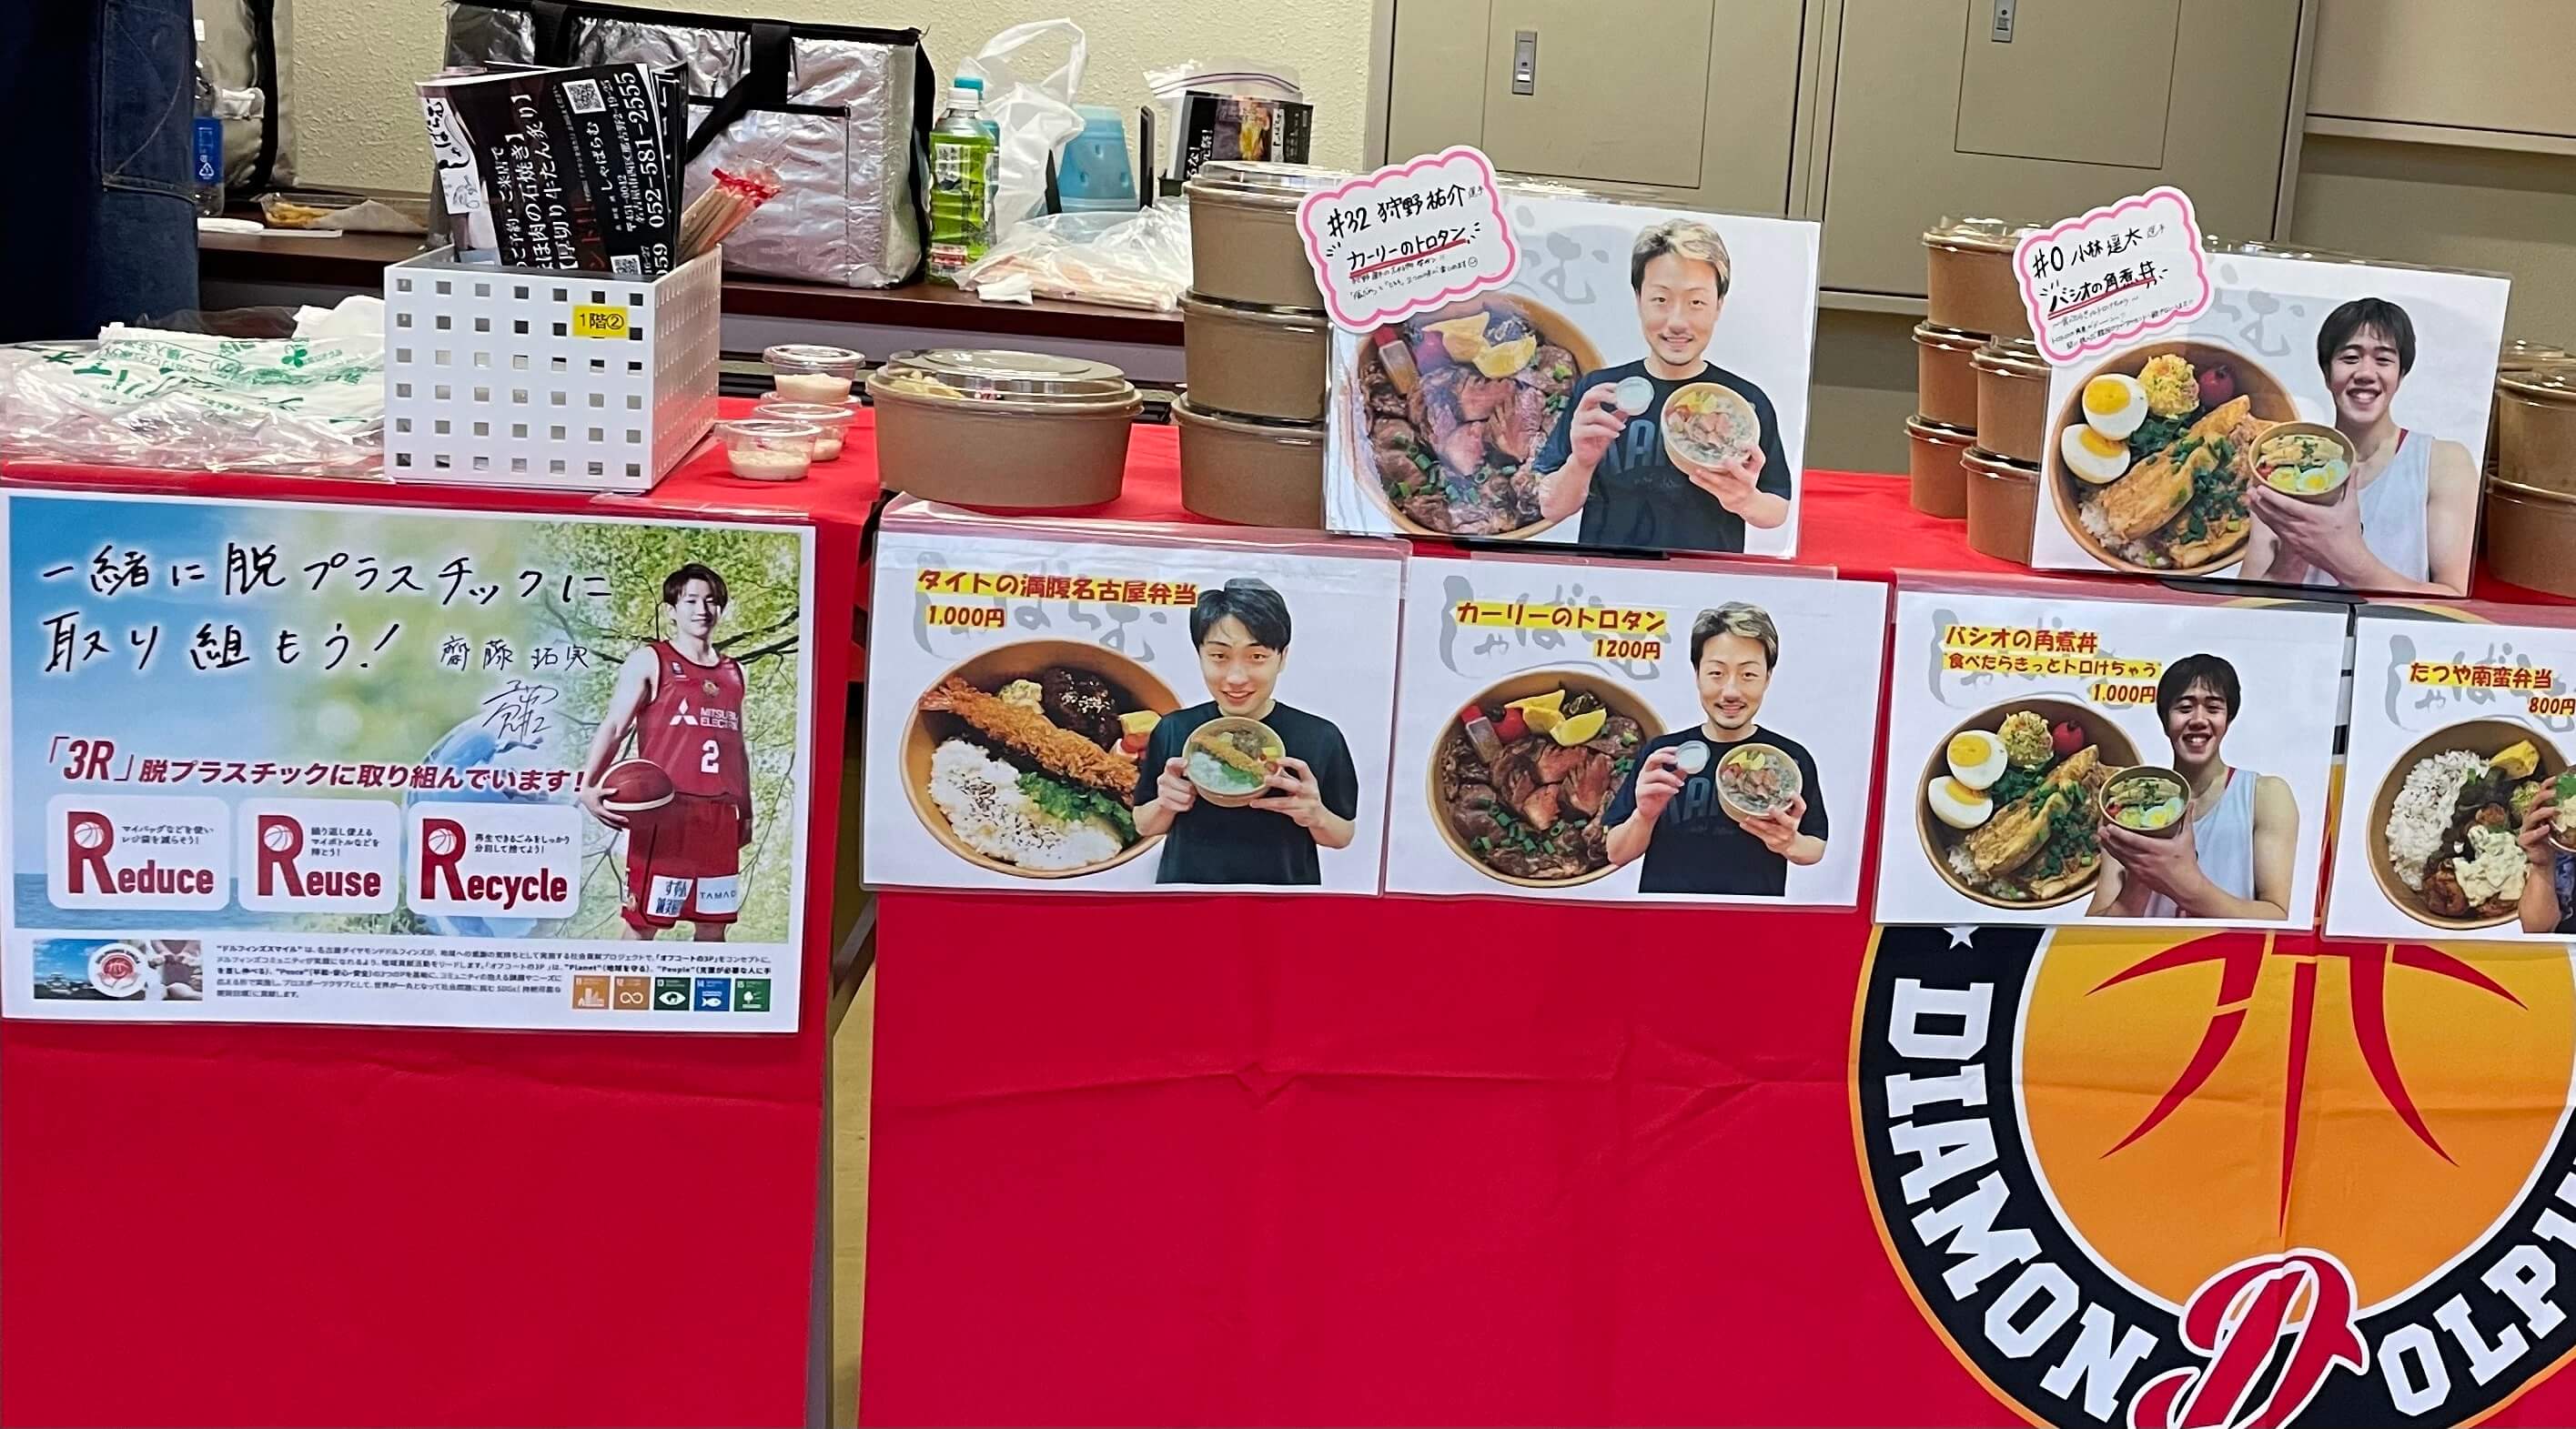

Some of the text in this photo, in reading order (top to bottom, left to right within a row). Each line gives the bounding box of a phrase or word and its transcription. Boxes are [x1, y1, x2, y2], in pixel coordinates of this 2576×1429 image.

[614, 72, 665, 228] 052-581-2555
[1327, 207, 1371, 239] #32
[1347, 226, 1466, 270] カーリーのトロタン
[2032, 246, 2065, 278] #0
[918, 569, 1197, 605] タイトの満腹名古屋弁当
[1458, 602, 1665, 632] カーリーのトロタン
[1597, 639, 1661, 659] 1200円
[2409, 662, 2553, 689] たつや南蛮弁当
[2529, 697, 2576, 715] 800円
[701, 740, 720, 773] 2
[67, 811, 214, 894] Reduce
[258, 814, 381, 898] Reuse
[420, 818, 568, 911] Recycle
